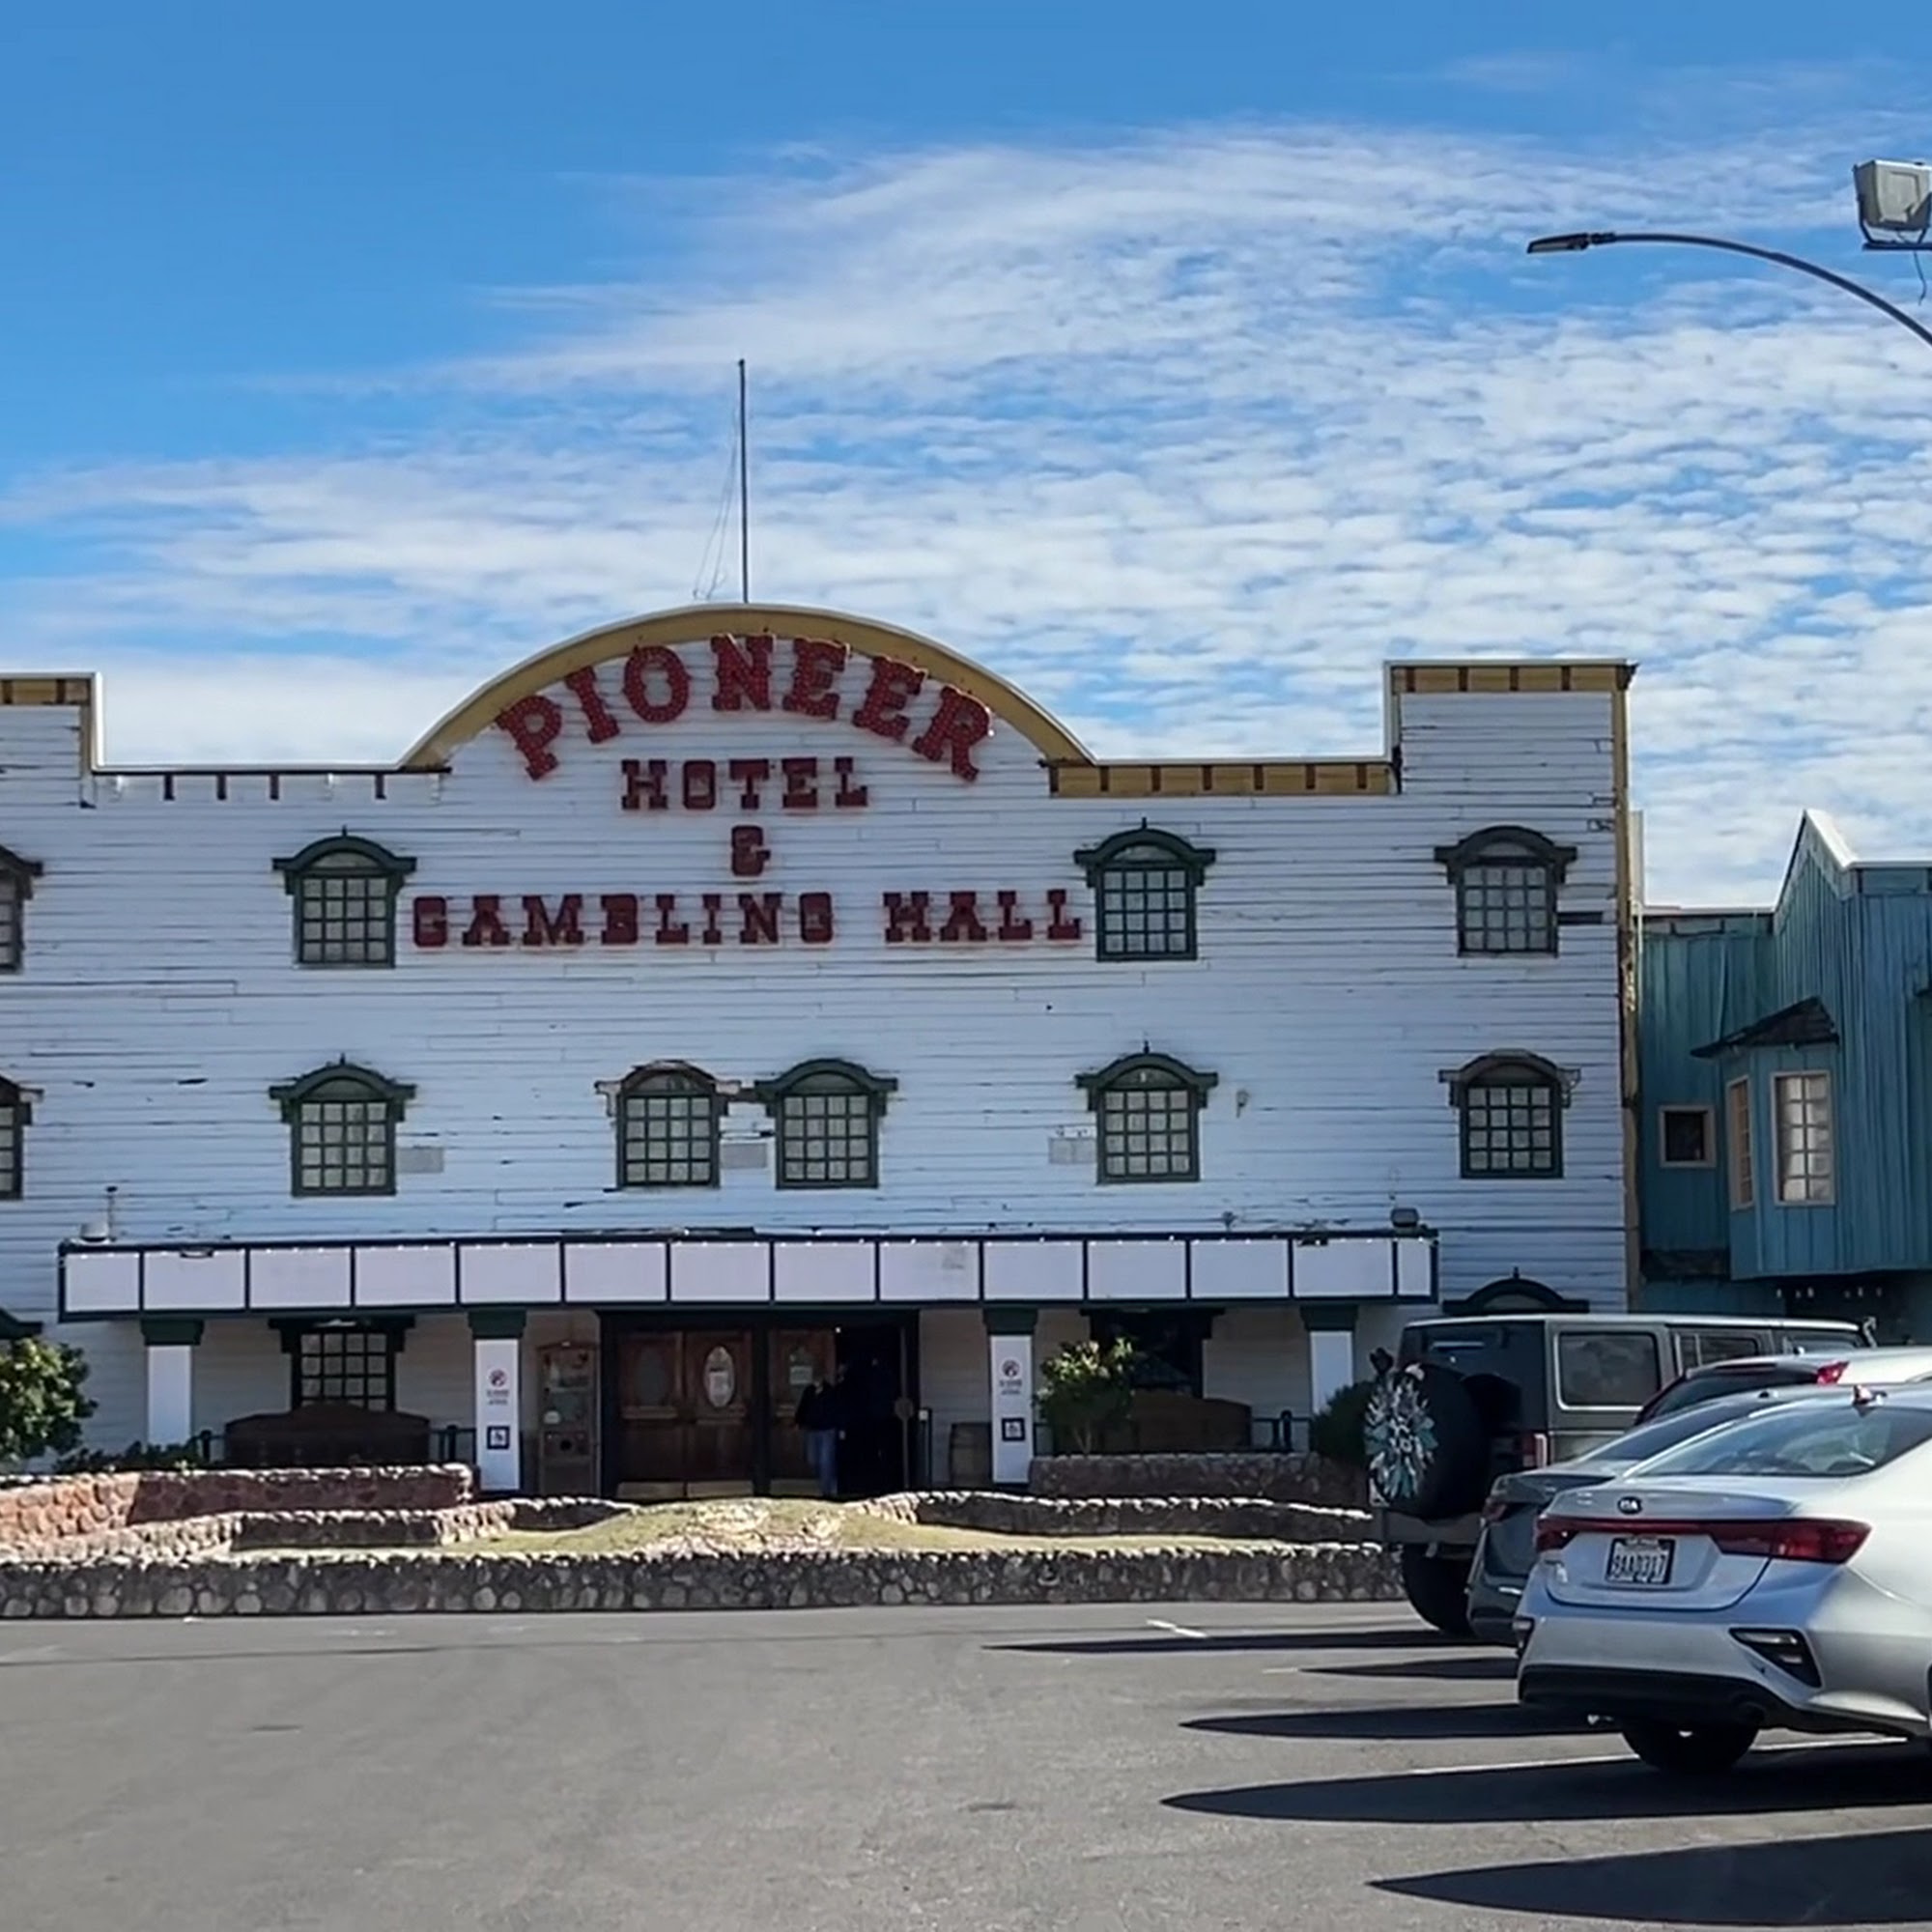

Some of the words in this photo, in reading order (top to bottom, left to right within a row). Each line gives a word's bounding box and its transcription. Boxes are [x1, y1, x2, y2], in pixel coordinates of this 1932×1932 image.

[496, 633, 993, 781] PIONEER
[621, 757, 868, 810] HOTEL
[731, 825, 771, 877] &
[412, 893, 834, 948] GAMBLING
[884, 889, 1084, 943] HALL
